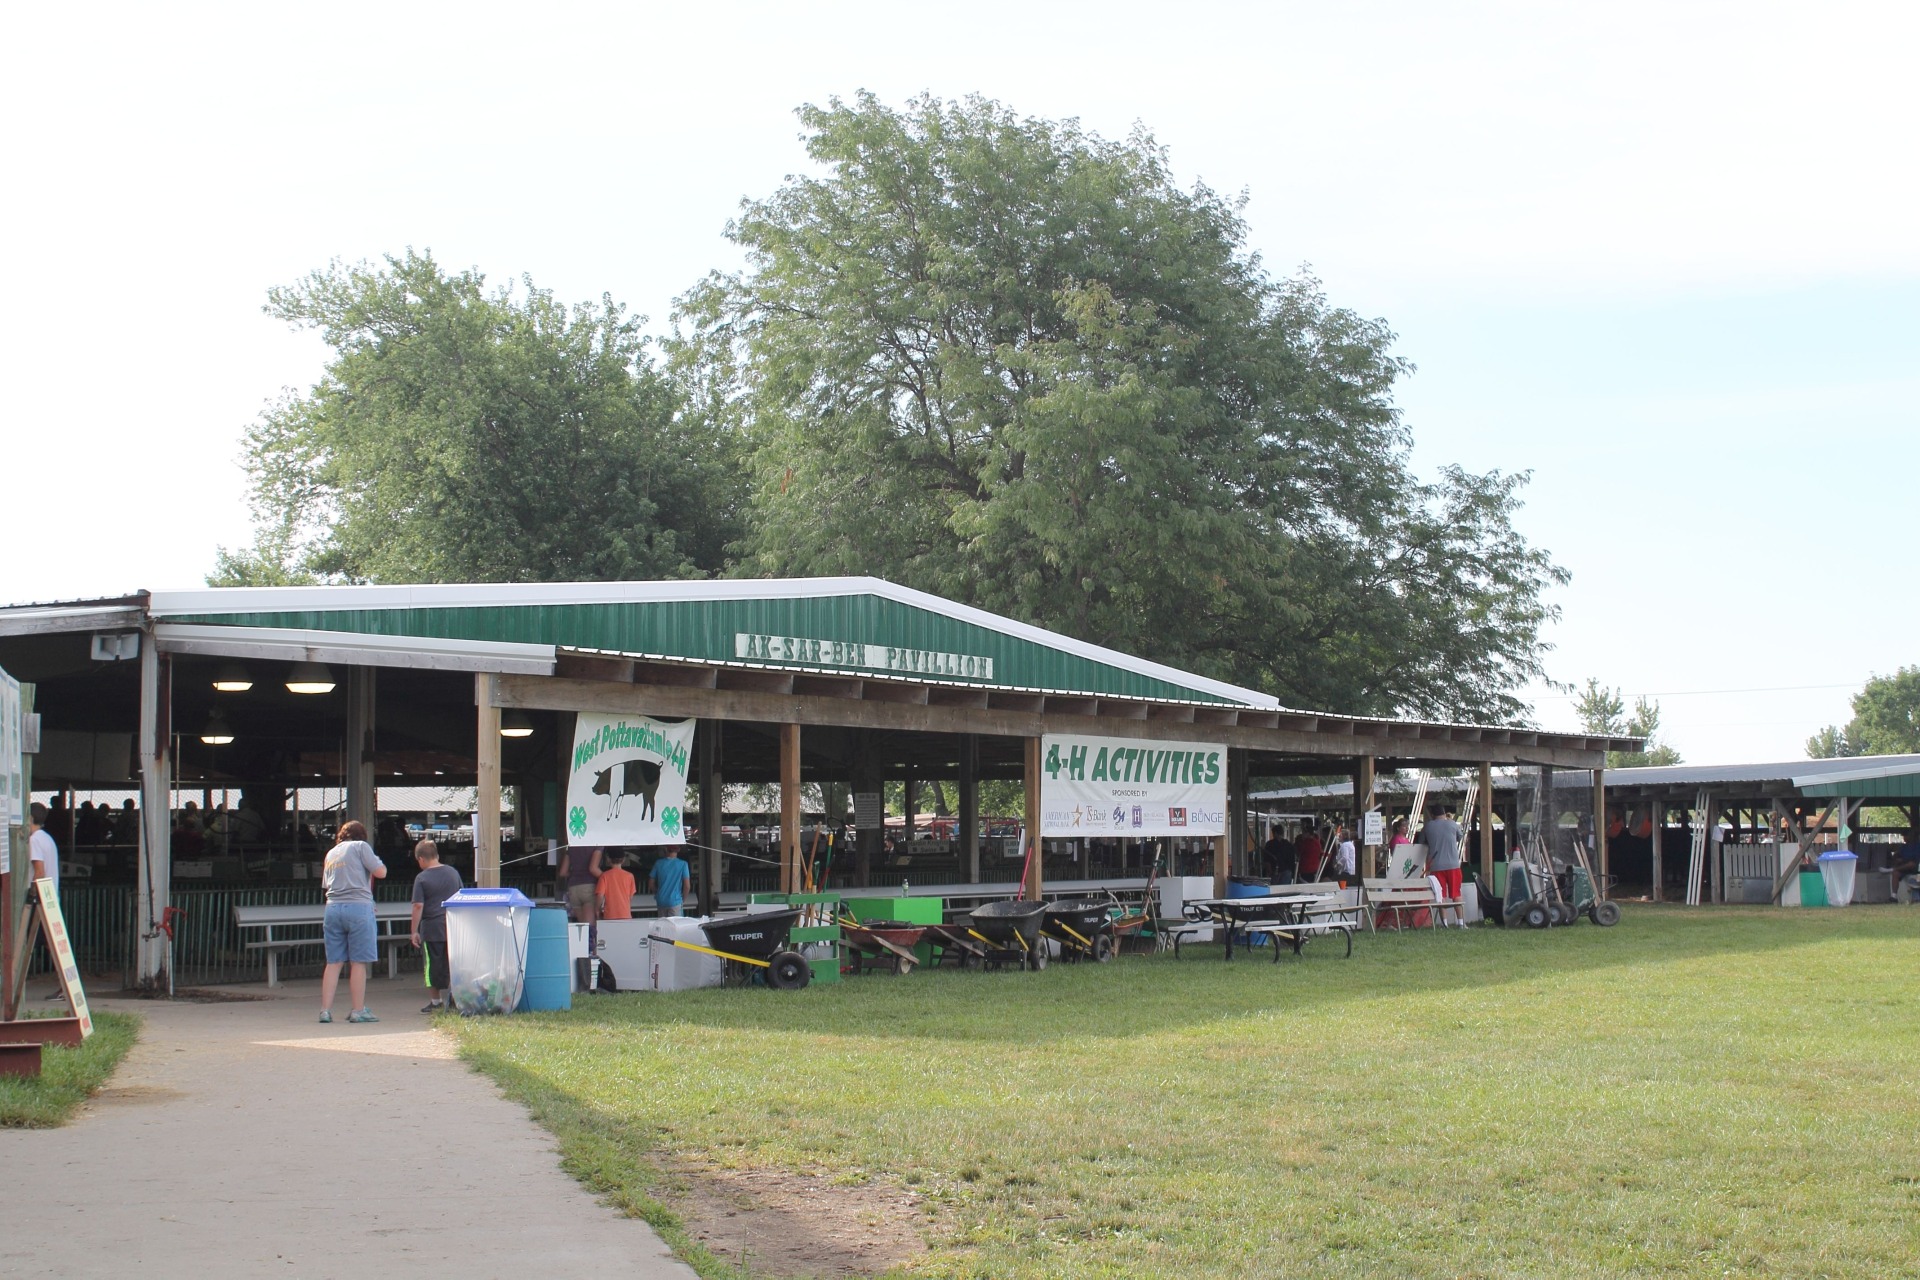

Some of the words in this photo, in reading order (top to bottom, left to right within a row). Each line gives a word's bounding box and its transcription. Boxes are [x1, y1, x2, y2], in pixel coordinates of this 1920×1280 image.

[747, 634, 866, 666] AK-SAR-BEN
[886, 647, 988, 678] PAVILLION
[574, 729, 600, 773] West
[1045, 744, 1088, 780] 4-H
[1091, 747, 1220, 784] ACTIVITIES
[1111, 789, 1140, 797] SPONSORED
[729, 932, 763, 941] TRUPER
